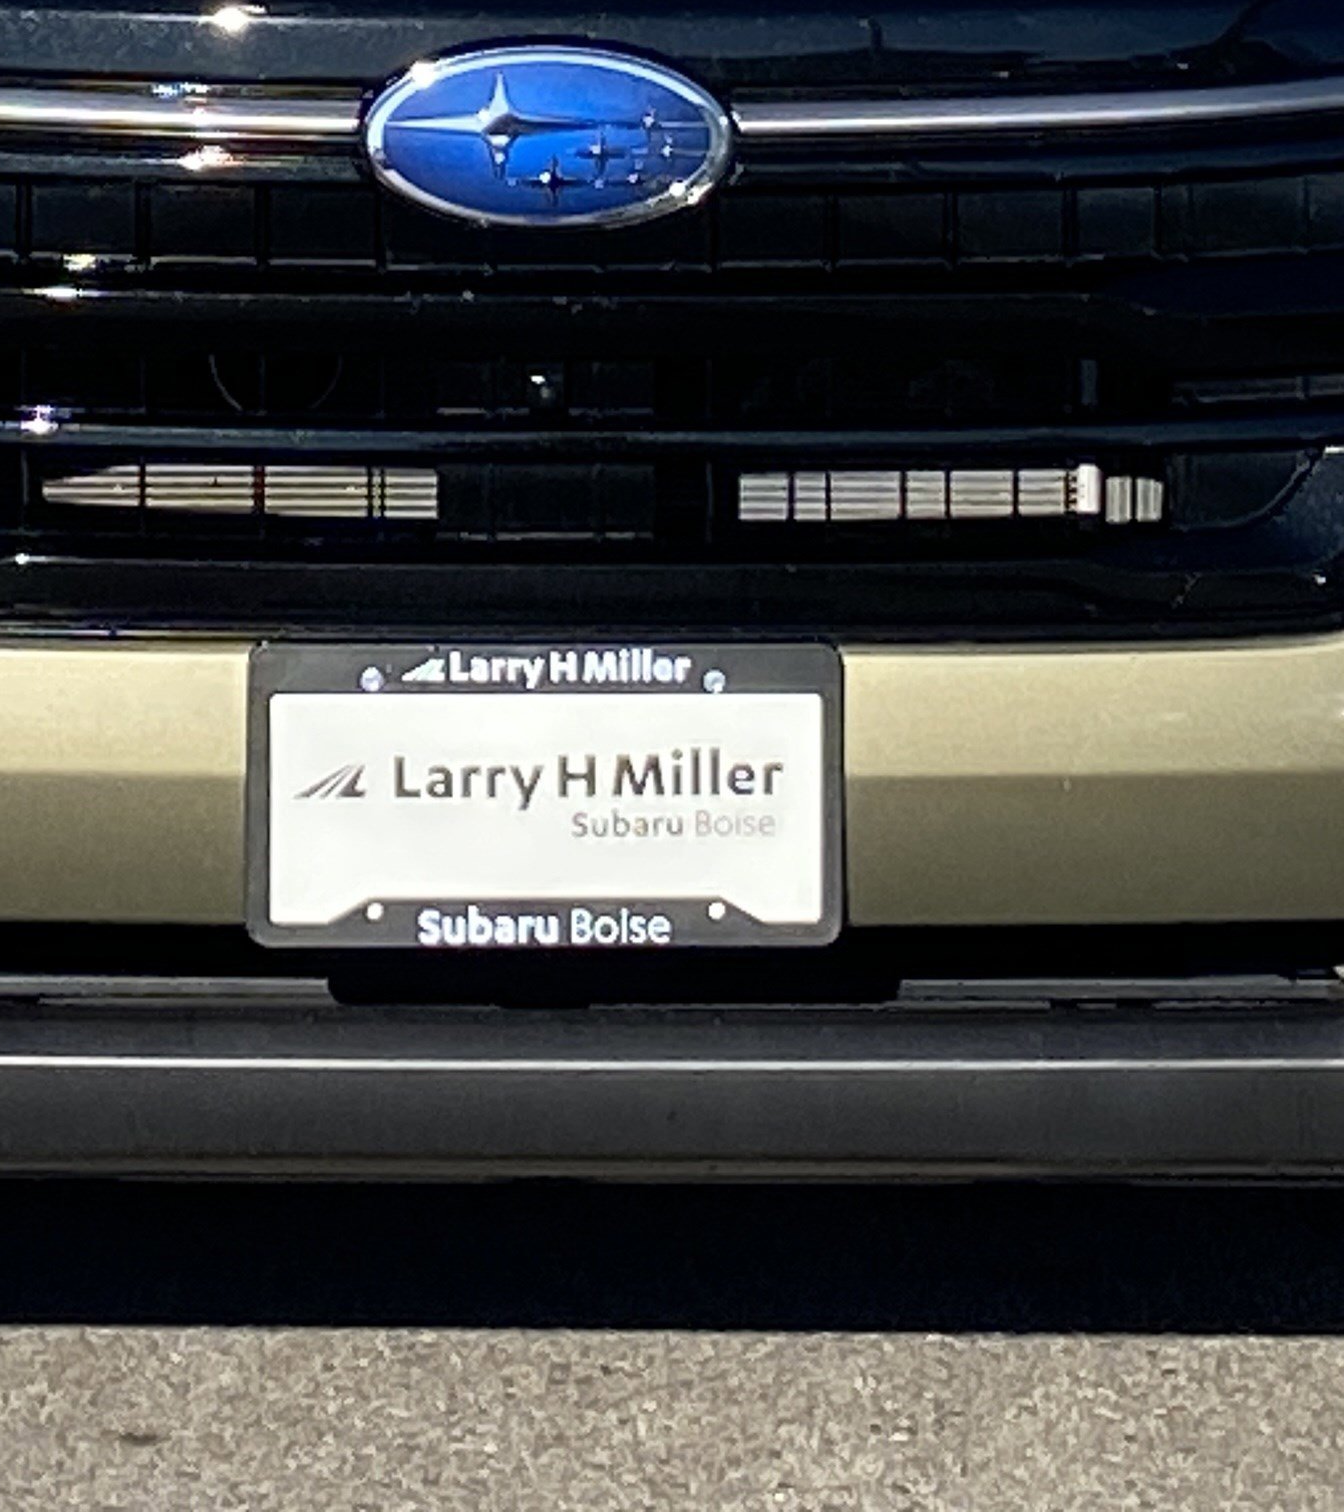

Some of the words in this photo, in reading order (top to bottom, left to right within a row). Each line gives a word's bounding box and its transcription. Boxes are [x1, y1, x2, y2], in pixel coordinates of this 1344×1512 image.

[448, 650, 545, 689] Larry
[550, 650, 578, 684] H
[582, 647, 692, 684] Miller
[394, 755, 544, 811] Larry
[558, 754, 597, 798] H
[612, 747, 785, 796] Miller
[571, 807, 685, 839] Subaru
[694, 808, 777, 838] Boise
[417, 905, 560, 946] Subaru
[569, 907, 673, 945] Boise
